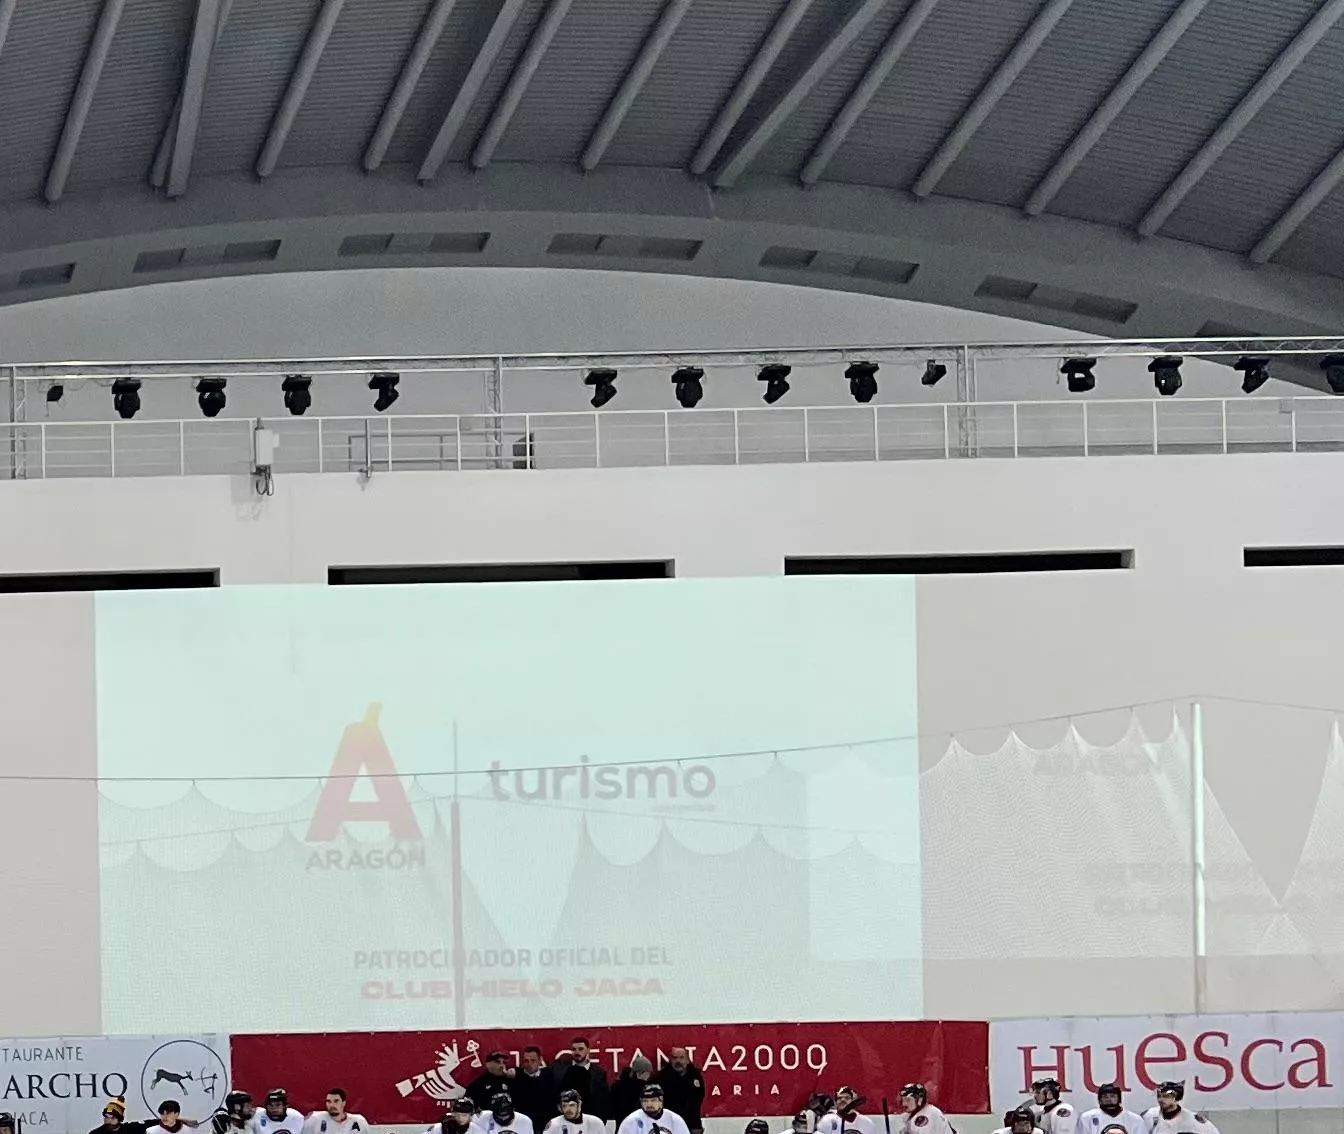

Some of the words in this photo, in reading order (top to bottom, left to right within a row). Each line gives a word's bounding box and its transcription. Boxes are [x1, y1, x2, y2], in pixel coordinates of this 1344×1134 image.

[489, 753, 718, 801] turismo
[353, 948, 533, 969] PATROCIADOR
[538, 946, 626, 967] OFICIAL
[360, 979, 453, 1000] CLUB
[463, 977, 564, 999] HIELO
[573, 976, 664, 998] JACA
